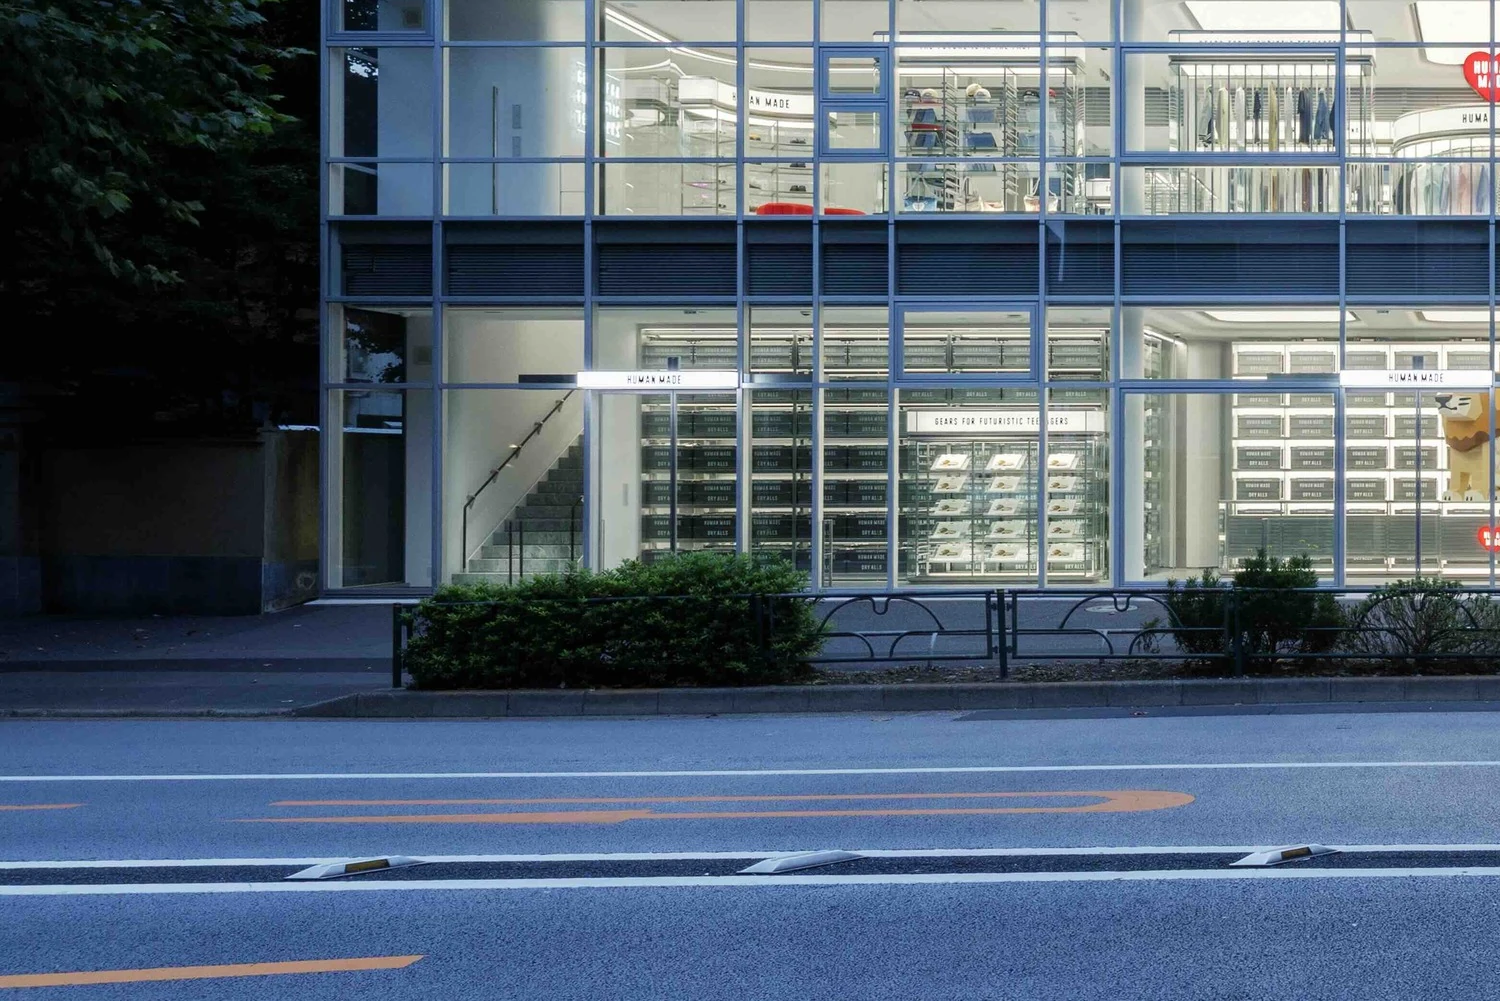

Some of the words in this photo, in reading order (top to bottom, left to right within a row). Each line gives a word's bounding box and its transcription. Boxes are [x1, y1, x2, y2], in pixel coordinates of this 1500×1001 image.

[765, 98, 790, 108] MADE
[1462, 113, 1488, 123] HUMA
[627, 374, 655, 384] HUMAN
[659, 374, 681, 384] MADE
[1389, 373, 1417, 382] HUMAN
[1421, 373, 1444, 382] MADE
[934, 417, 958, 425] GEARS
[962, 417, 975, 425] FOR
[979, 417, 1023, 425] FUTURISTIC
[1027, 417, 1068, 425] TEEGERS
[1485, 538, 1500, 546] MDE
